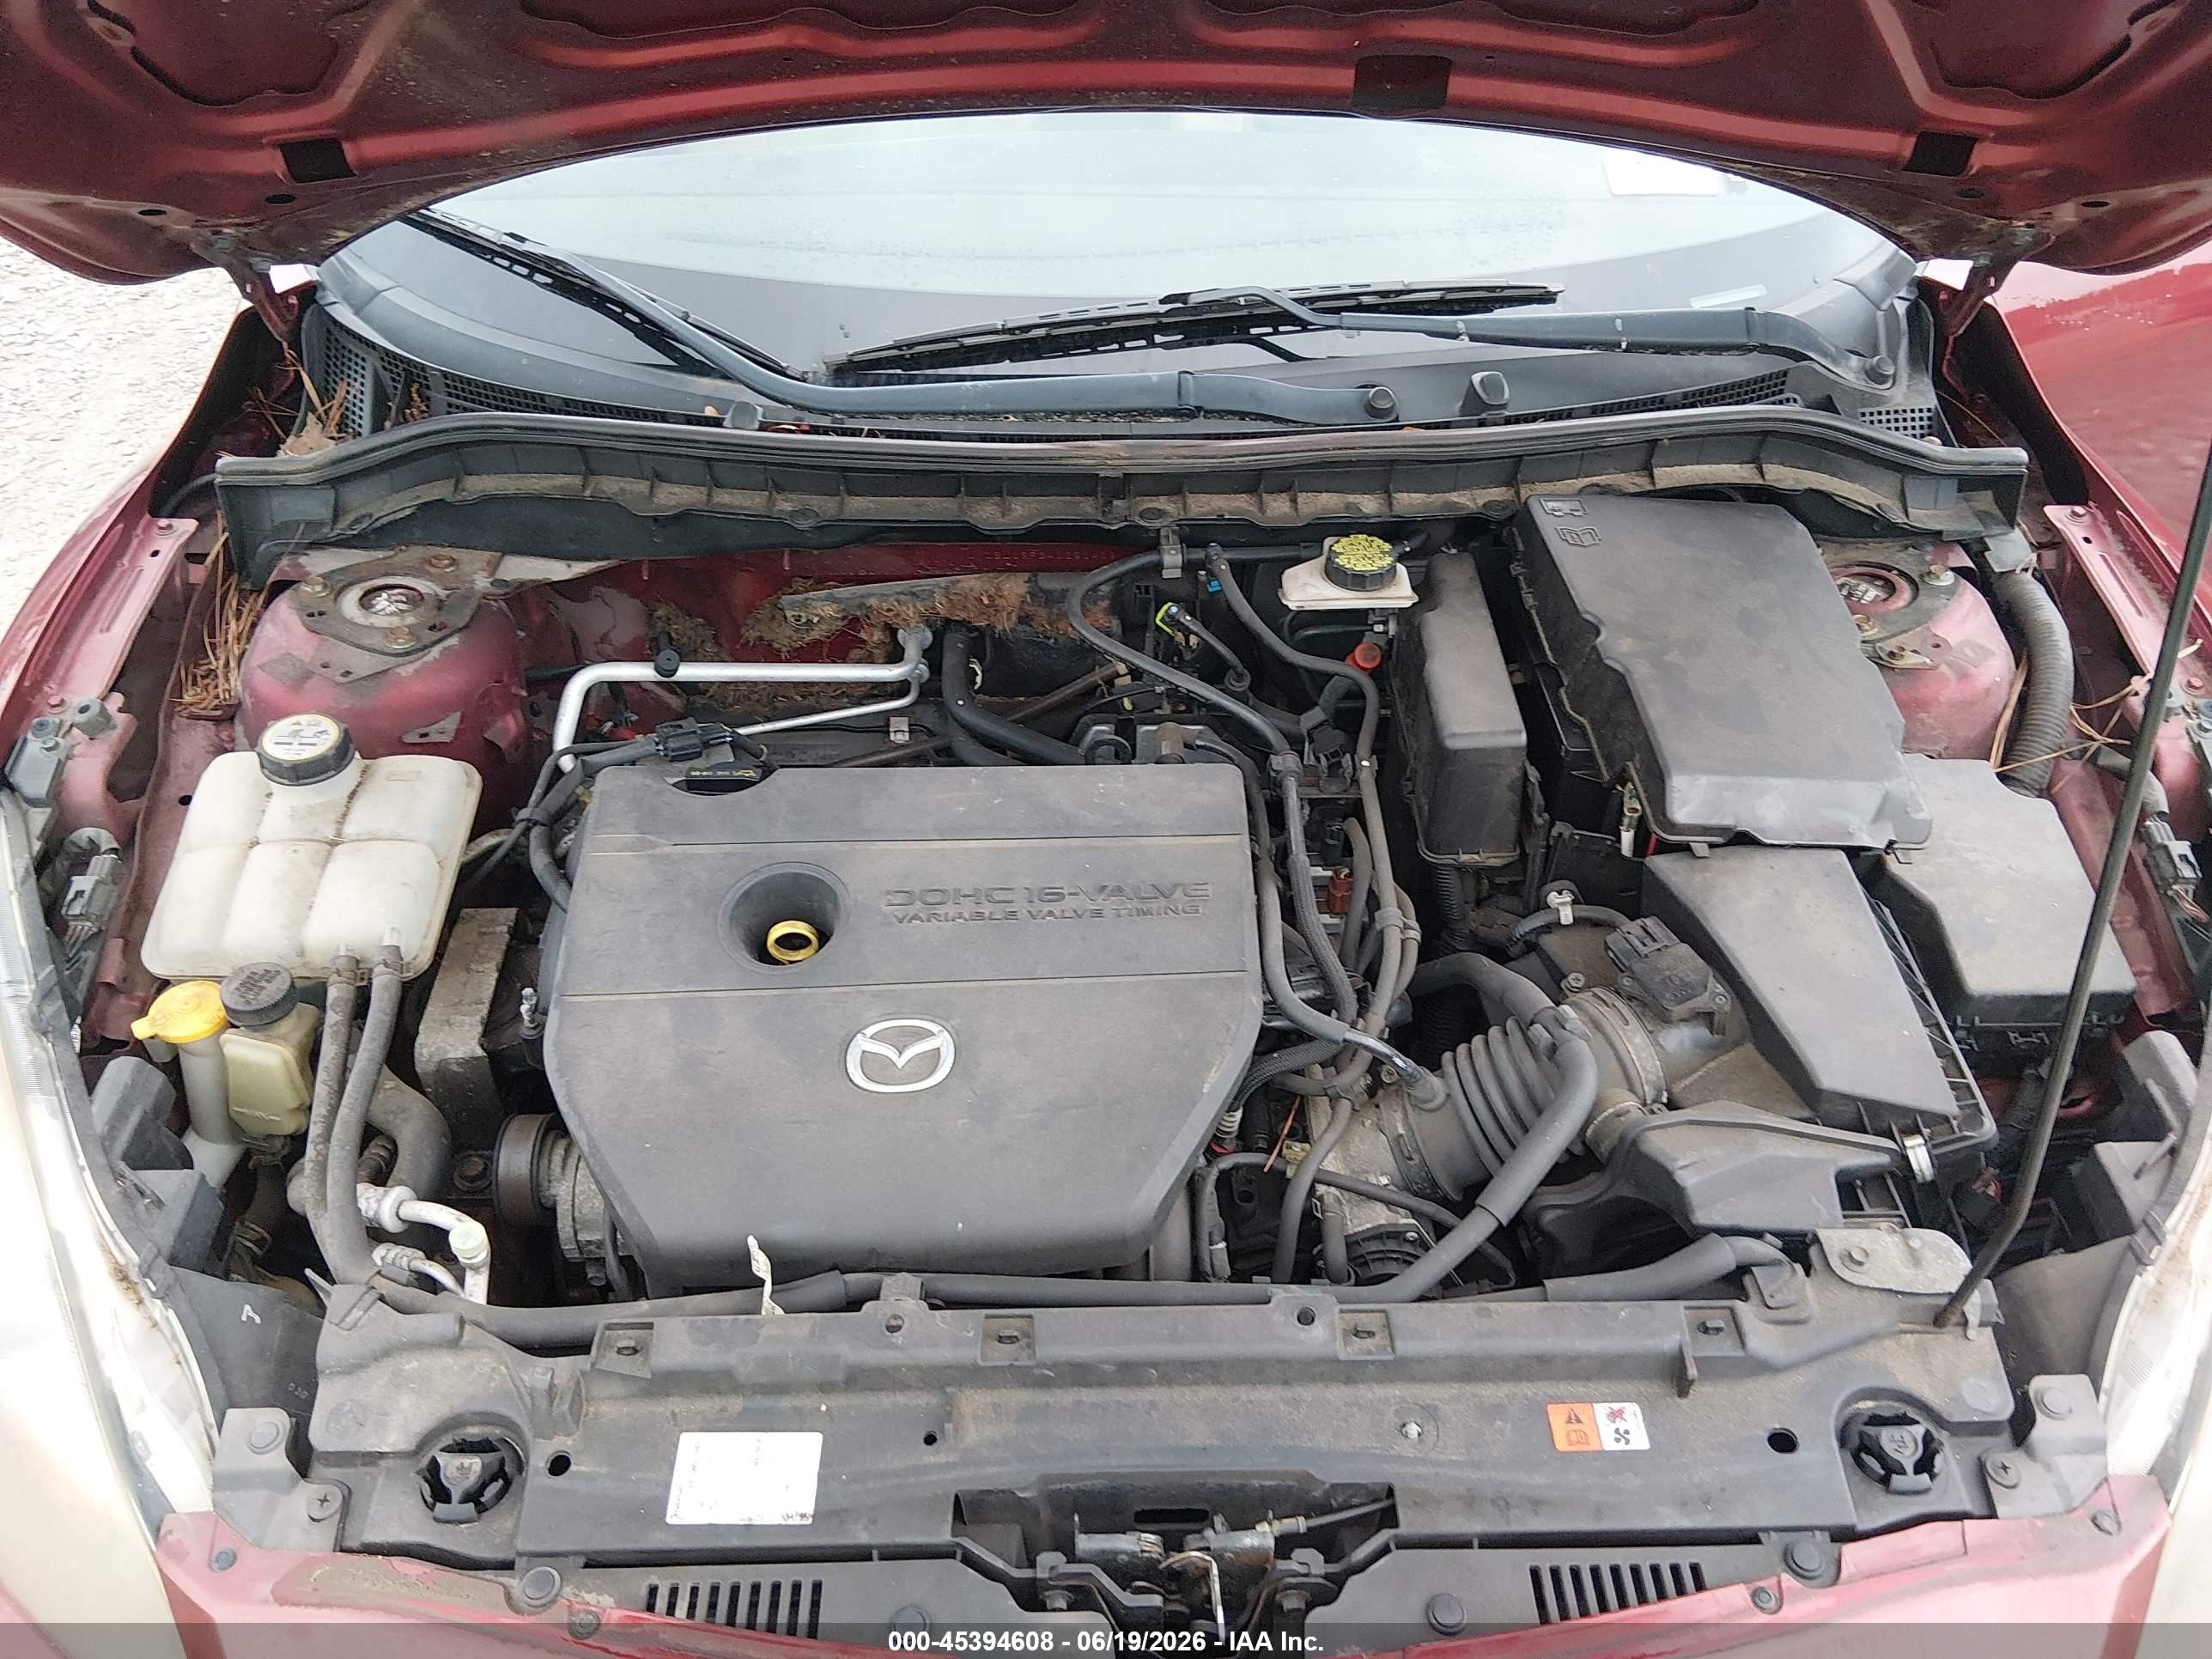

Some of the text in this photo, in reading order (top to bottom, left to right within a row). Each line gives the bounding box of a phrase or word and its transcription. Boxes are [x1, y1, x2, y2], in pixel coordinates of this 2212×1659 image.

[885, 882, 1211, 907] DOHC 16-VALVE
[892, 904, 1203, 925] VARIABLE VALVE TIMING
